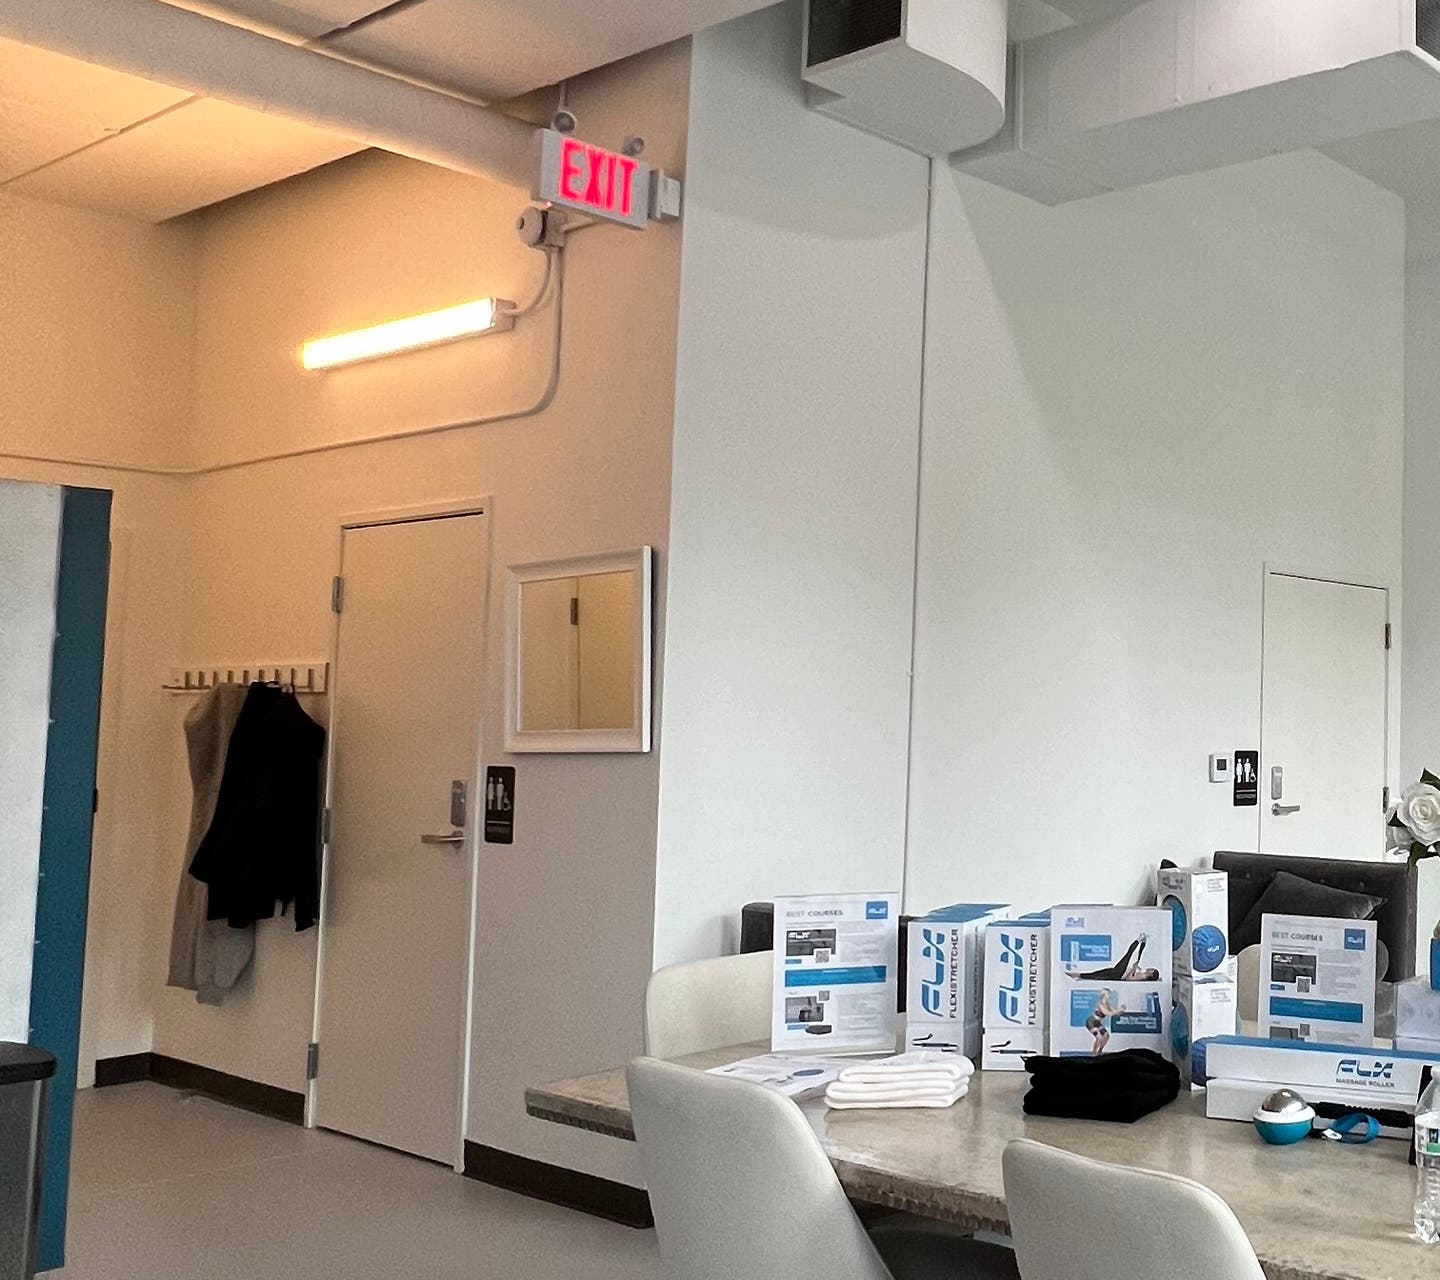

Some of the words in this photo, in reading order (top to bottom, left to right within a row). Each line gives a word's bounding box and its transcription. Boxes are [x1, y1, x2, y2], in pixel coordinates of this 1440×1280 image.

[559, 137, 639, 217] EXIT
[807, 909, 844, 917] COURSES
[922, 928, 945, 1017] FLX
[949, 929, 959, 1018] FLEXISTRETCHER
[999, 933, 1024, 1025] FLX
[1028, 933, 1038, 1025] FLEXISTRETCHER
[1336, 1059, 1394, 1079] FLX
